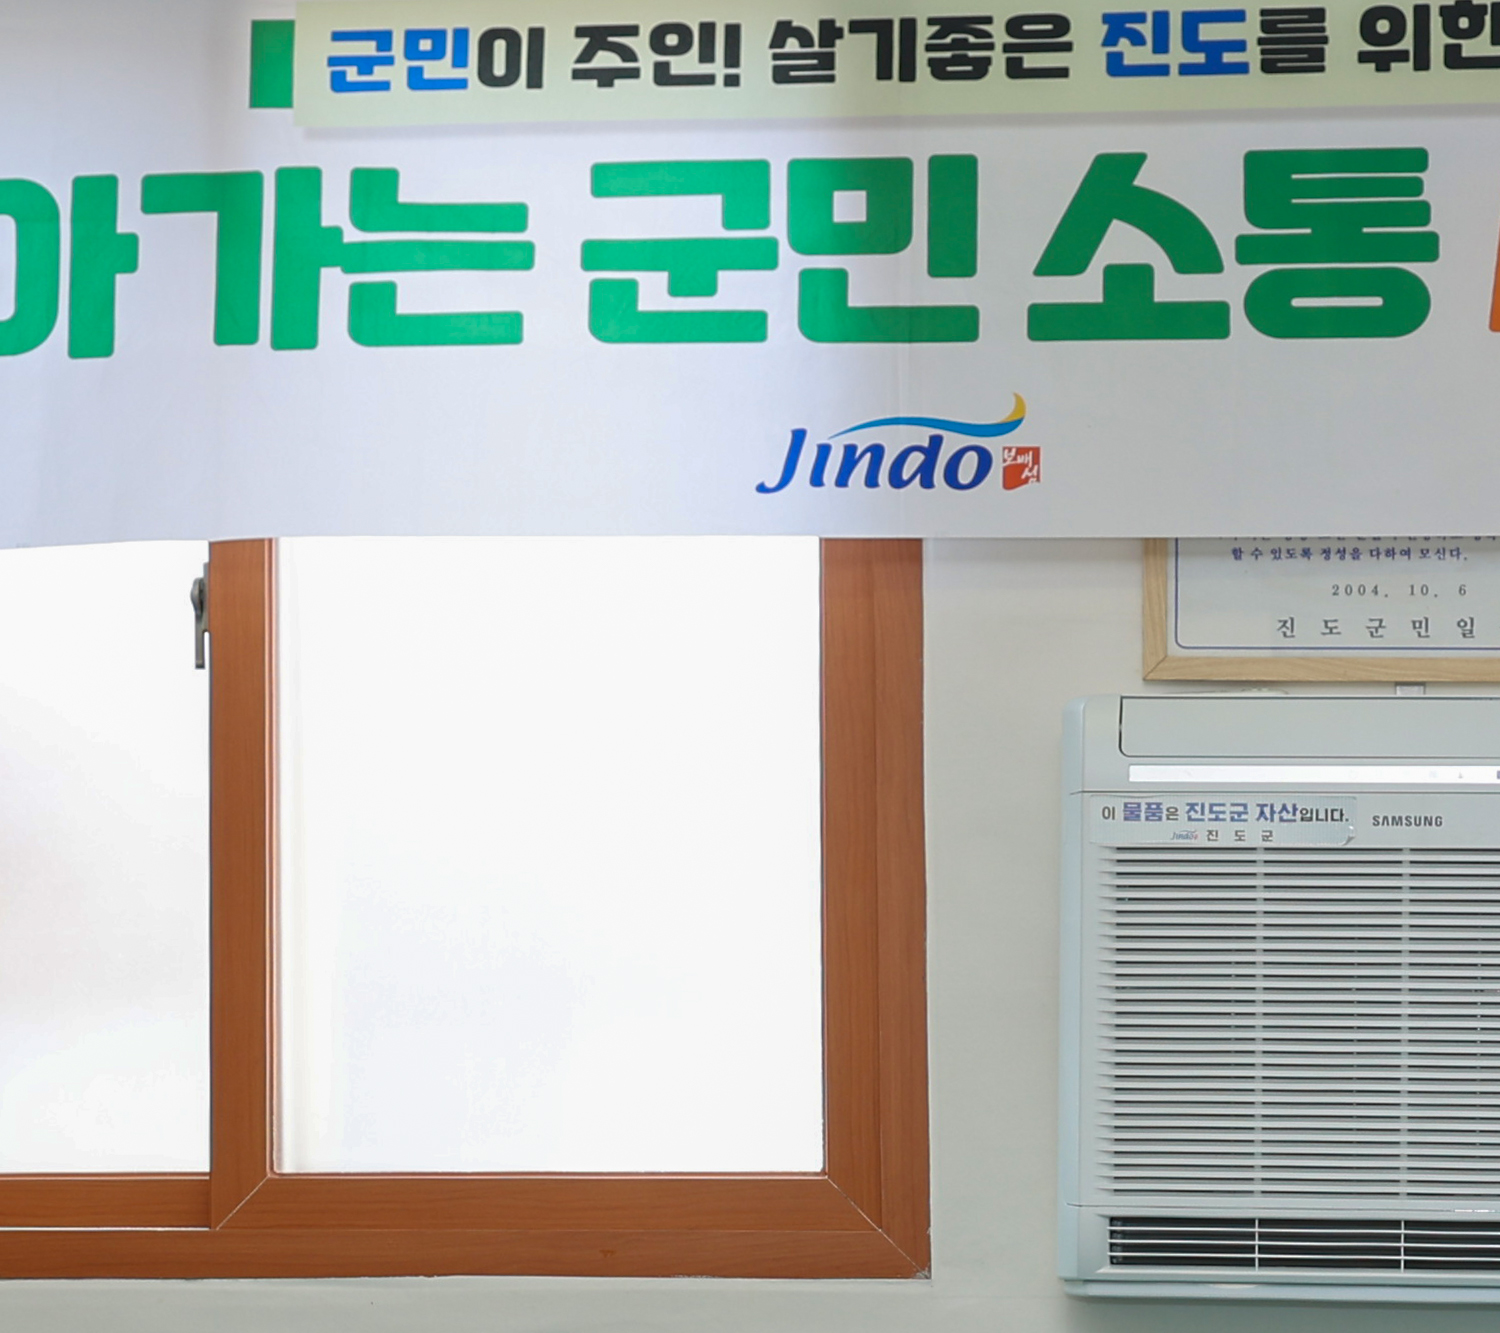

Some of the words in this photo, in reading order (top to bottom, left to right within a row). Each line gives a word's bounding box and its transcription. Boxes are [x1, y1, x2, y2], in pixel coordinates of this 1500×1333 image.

[327, 27, 545, 93] 군민이
[571, 22, 742, 88] 주인!
[768, 14, 1074, 84] 살기좋은
[1100, 8, 1329, 78] 진도를
[580, 153, 980, 344] 군민
[1026, 147, 1441, 341] 소통
[755, 428, 993, 494] Jindo
[1251, 547, 1264, 561] 수
[1270, 547, 1314, 561] 있도록
[1320, 547, 1363, 561] 정성을
[1369, 547, 1412, 561] 다하여
[1418, 547, 1468, 561] 모신다.
[1332, 584, 1389, 598] 2004.
[1409, 584, 1438, 598] 10.
[1458, 584, 1467, 597] 6
[1102, 806, 1116, 821] 이
[1122, 802, 1179, 822] 물품은
[1185, 803, 1249, 822] 진도군
[1255, 802, 1350, 823] 자산입니다.
[1372, 815, 1443, 828] SAMSUNG
